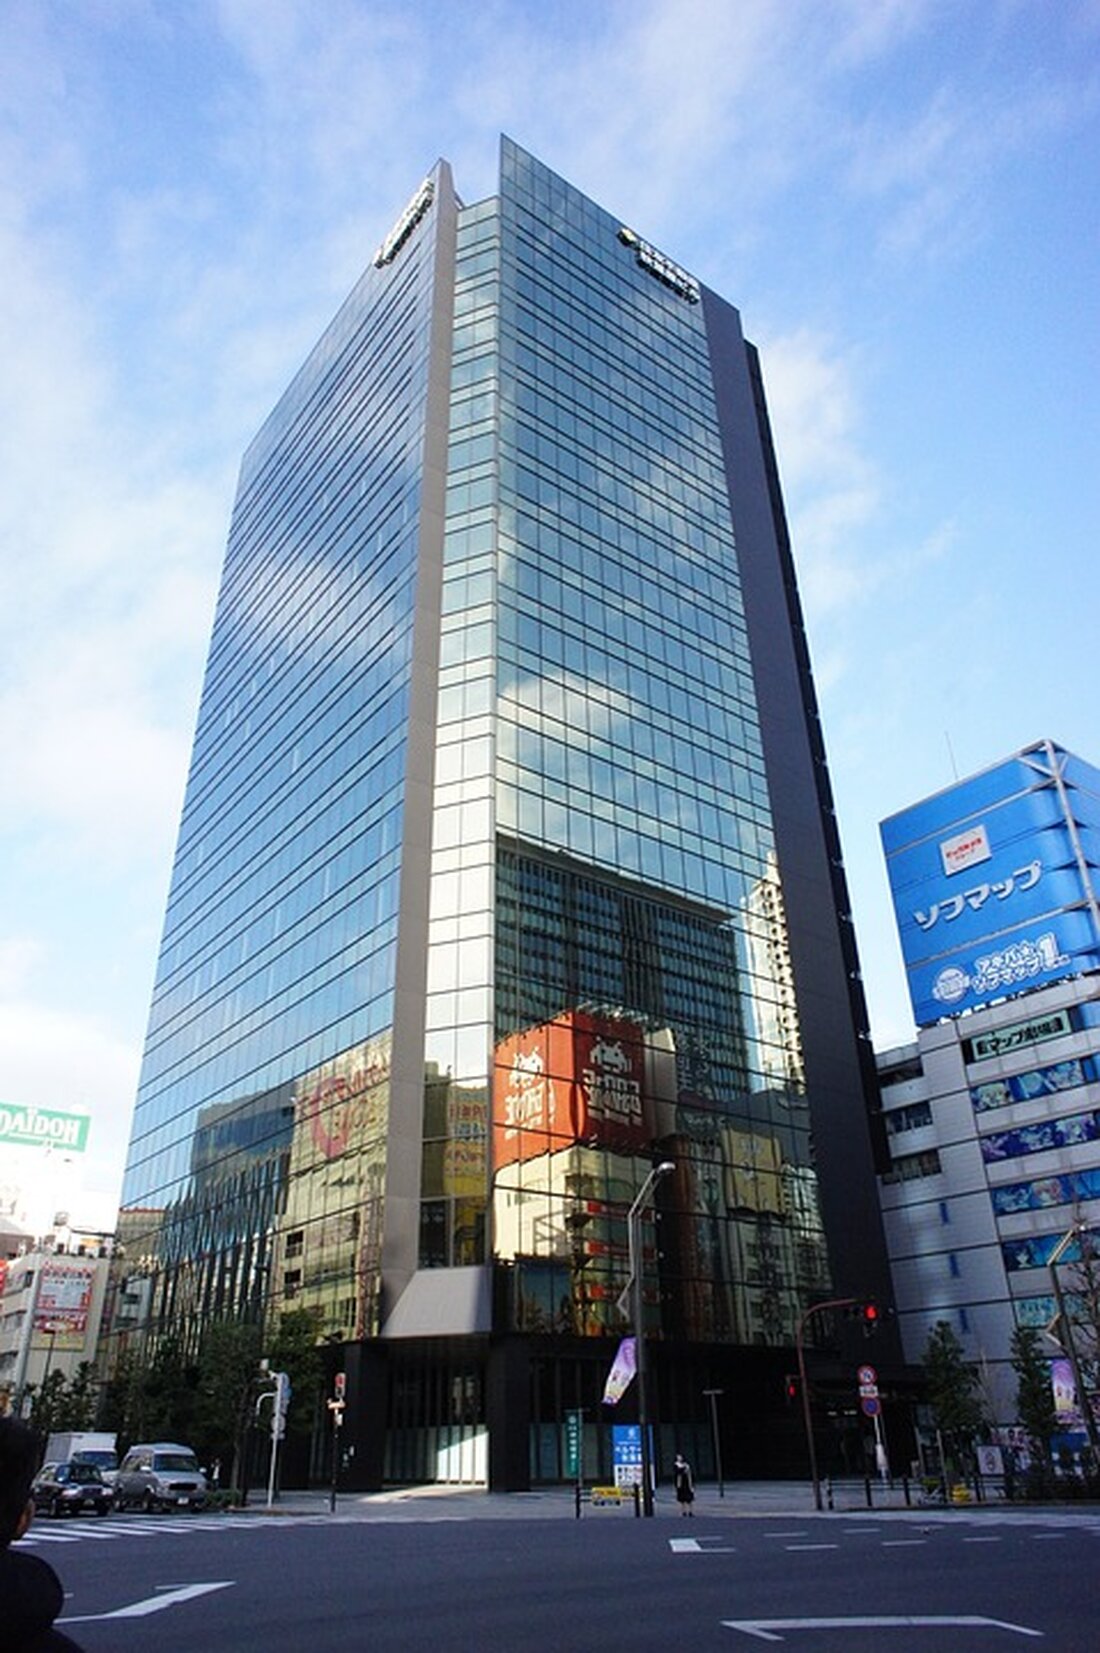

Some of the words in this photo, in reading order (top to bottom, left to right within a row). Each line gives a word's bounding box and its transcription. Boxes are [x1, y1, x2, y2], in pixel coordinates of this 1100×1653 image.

[913, 861, 1042, 930] ソフマップ
